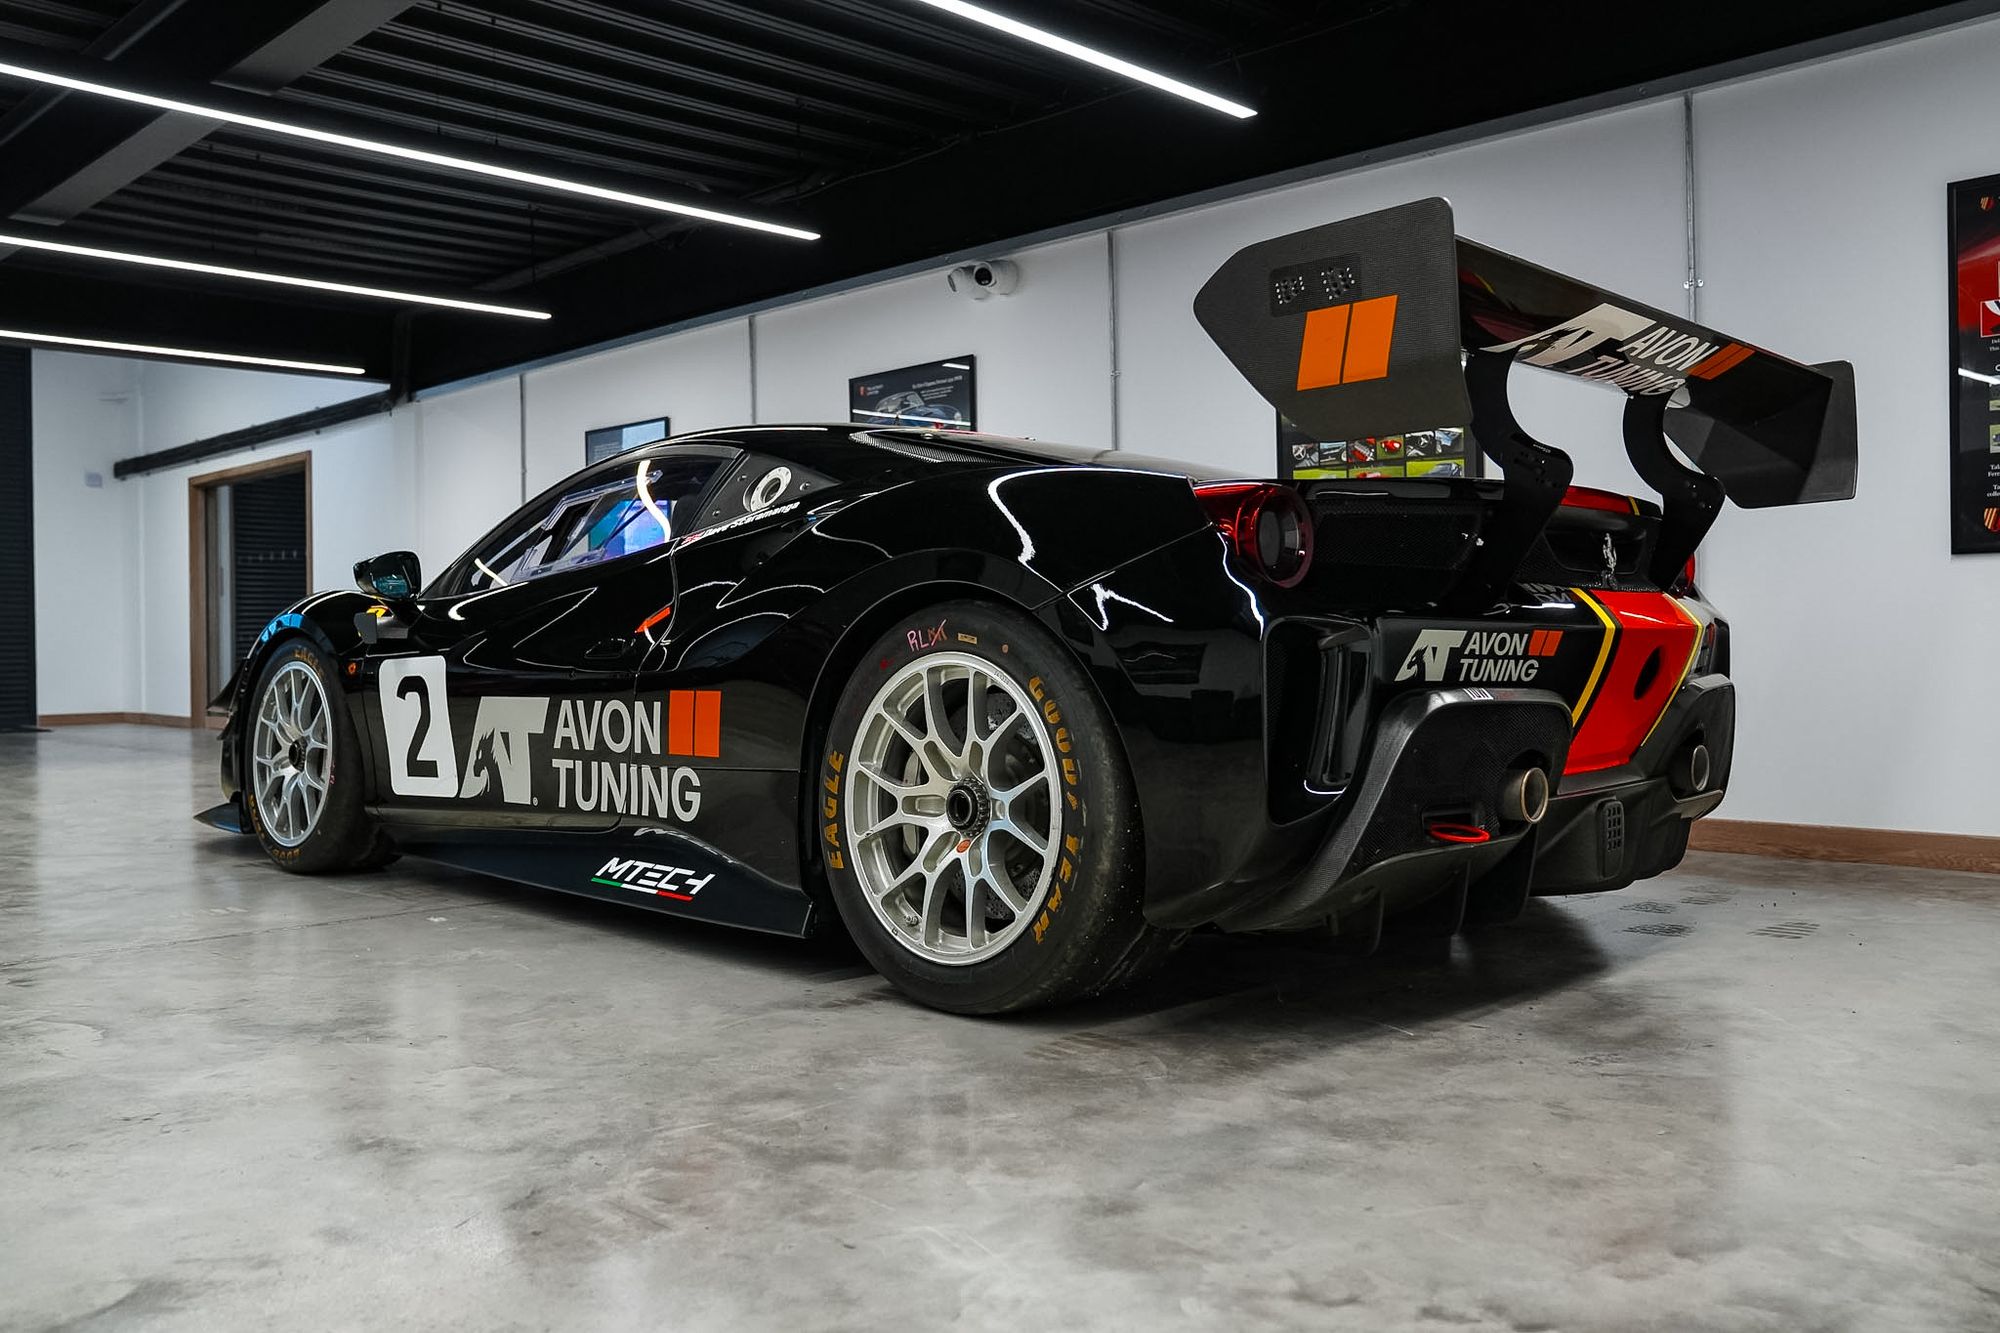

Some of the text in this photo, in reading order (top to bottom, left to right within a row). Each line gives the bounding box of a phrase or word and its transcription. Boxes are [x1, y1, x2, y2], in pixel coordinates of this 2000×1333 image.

[1616, 326, 1719, 371] AVON
[1565, 355, 1686, 395] TUNING
[1464, 632, 1528, 656] AVON
[1459, 659, 1539, 682] TUNING
[396, 675, 439, 778] 2
[553, 700, 662, 755] AVON
[552, 758, 701, 822] TUNING
[823, 750, 845, 869] EAGLE
[595, 857, 716, 895] MTECH
